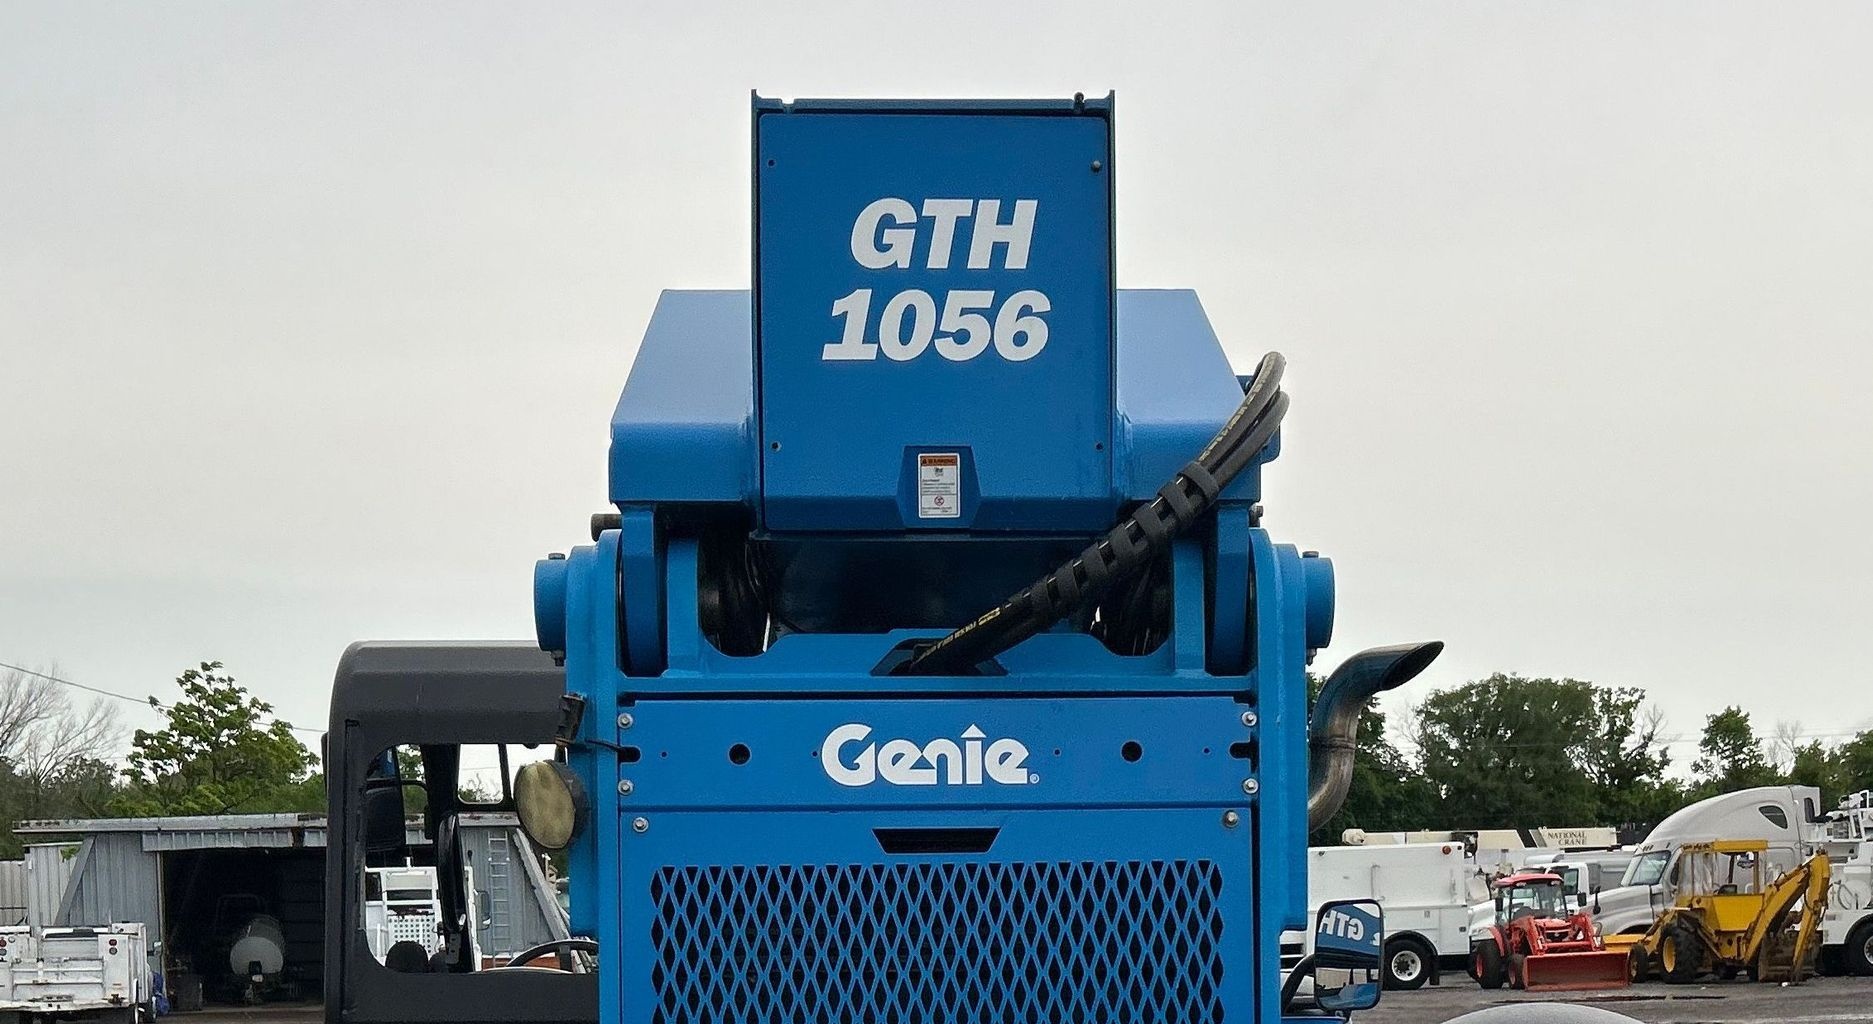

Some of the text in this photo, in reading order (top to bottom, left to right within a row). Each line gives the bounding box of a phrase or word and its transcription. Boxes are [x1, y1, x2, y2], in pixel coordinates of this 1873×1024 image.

[850, 197, 1038, 269] GTH
[822, 288, 1051, 361] 1056
[821, 723, 1029, 786] Genie
[1548, 831, 1587, 839] NATIONAL
